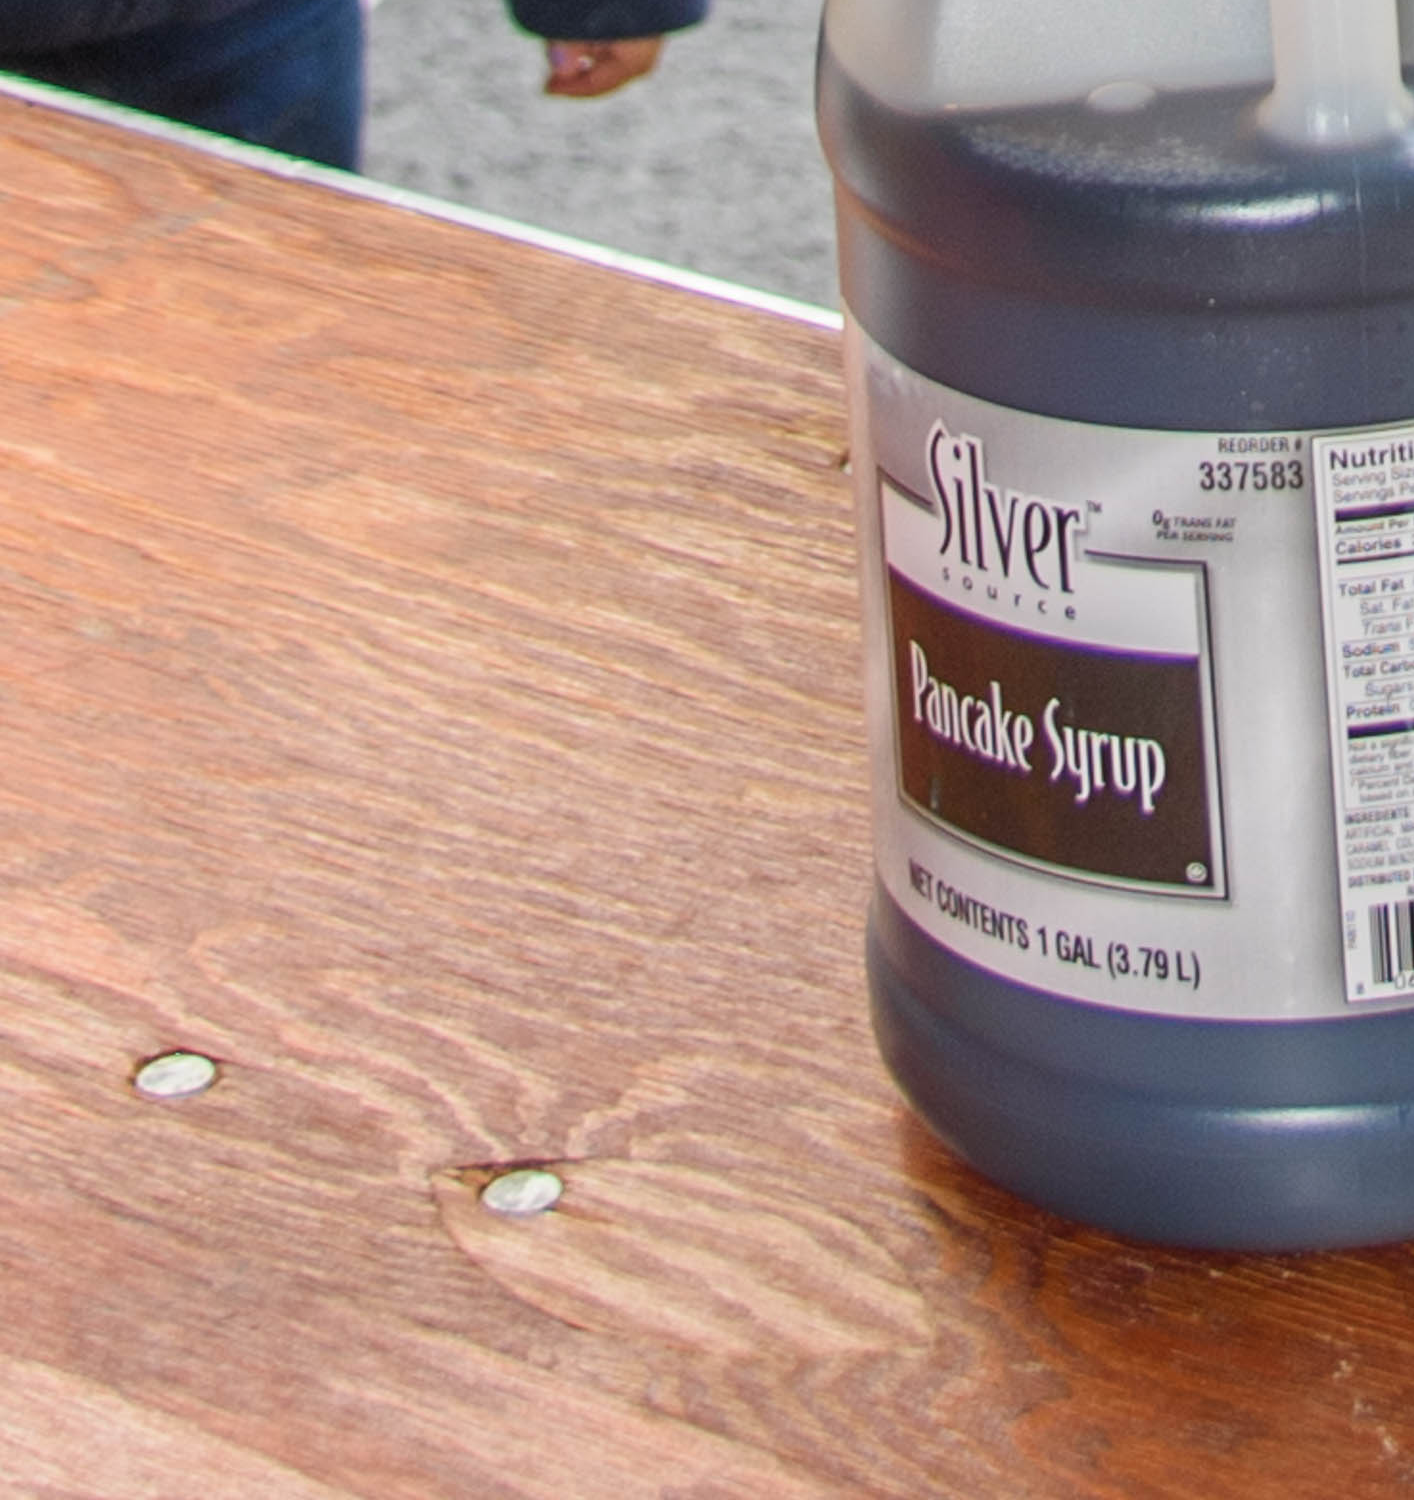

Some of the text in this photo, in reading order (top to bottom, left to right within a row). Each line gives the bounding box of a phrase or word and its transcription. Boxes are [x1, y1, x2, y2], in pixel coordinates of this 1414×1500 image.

[1218, 437, 1290, 453] REORDER
[1199, 460, 1304, 491] 337583
[1332, 468, 1386, 487] Serving
[1333, 484, 1395, 503] Servings
[930, 427, 1080, 593] Silver
[1335, 537, 1401, 555] Calories
[1338, 580, 1376, 597] Total
[1380, 577, 1404, 593] Fat
[1391, 596, 1414, 613] Fat
[1362, 617, 1401, 636] Trans
[1341, 641, 1400, 658] Sodium
[1343, 662, 1376, 679] Total
[1365, 679, 1414, 700] Sugars
[1346, 701, 1401, 719] Protein
[909, 639, 1166, 814] Pancake Syrup
[909, 857, 1202, 990] NET CONTENTS 1 GAL (3.79 L)
